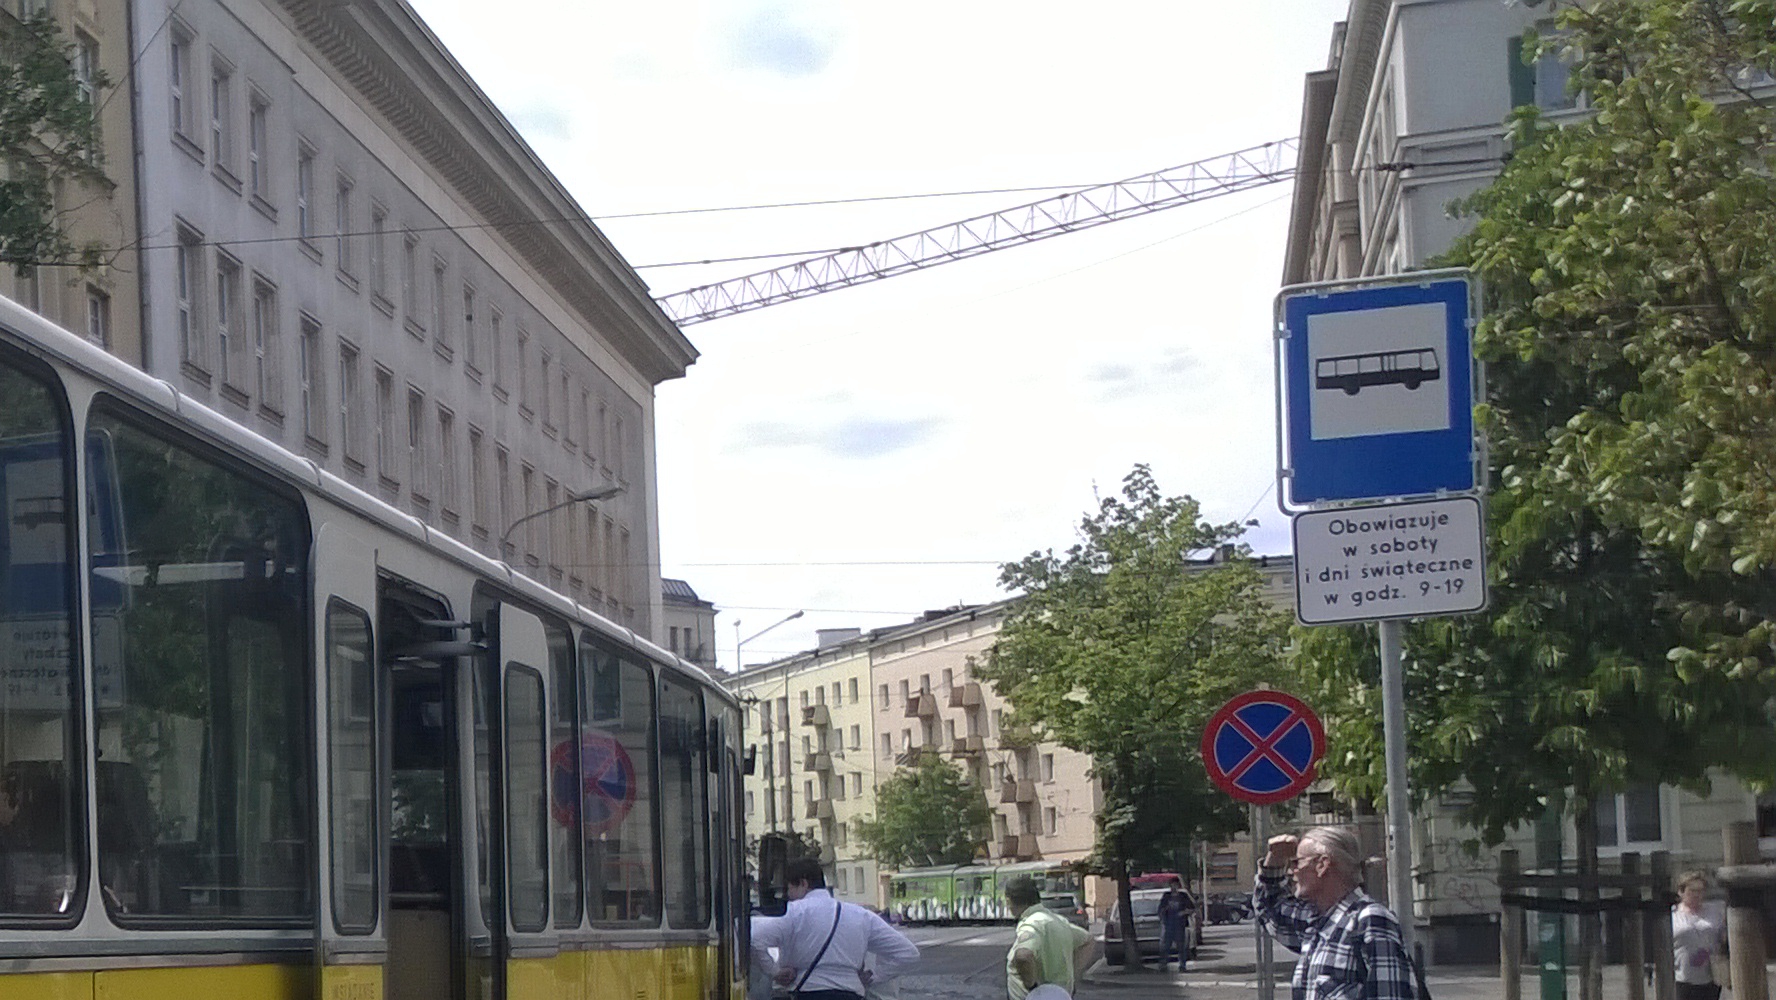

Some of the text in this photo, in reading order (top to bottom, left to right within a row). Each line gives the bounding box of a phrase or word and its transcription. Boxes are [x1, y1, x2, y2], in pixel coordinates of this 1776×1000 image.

[1328, 511, 1449, 535] Obowiązuje
[1342, 536, 1438, 557] w soboty
[1305, 558, 1473, 583] i dni świąteczne
[1324, 593, 1338, 605] w
[1351, 584, 1406, 607] godz.
